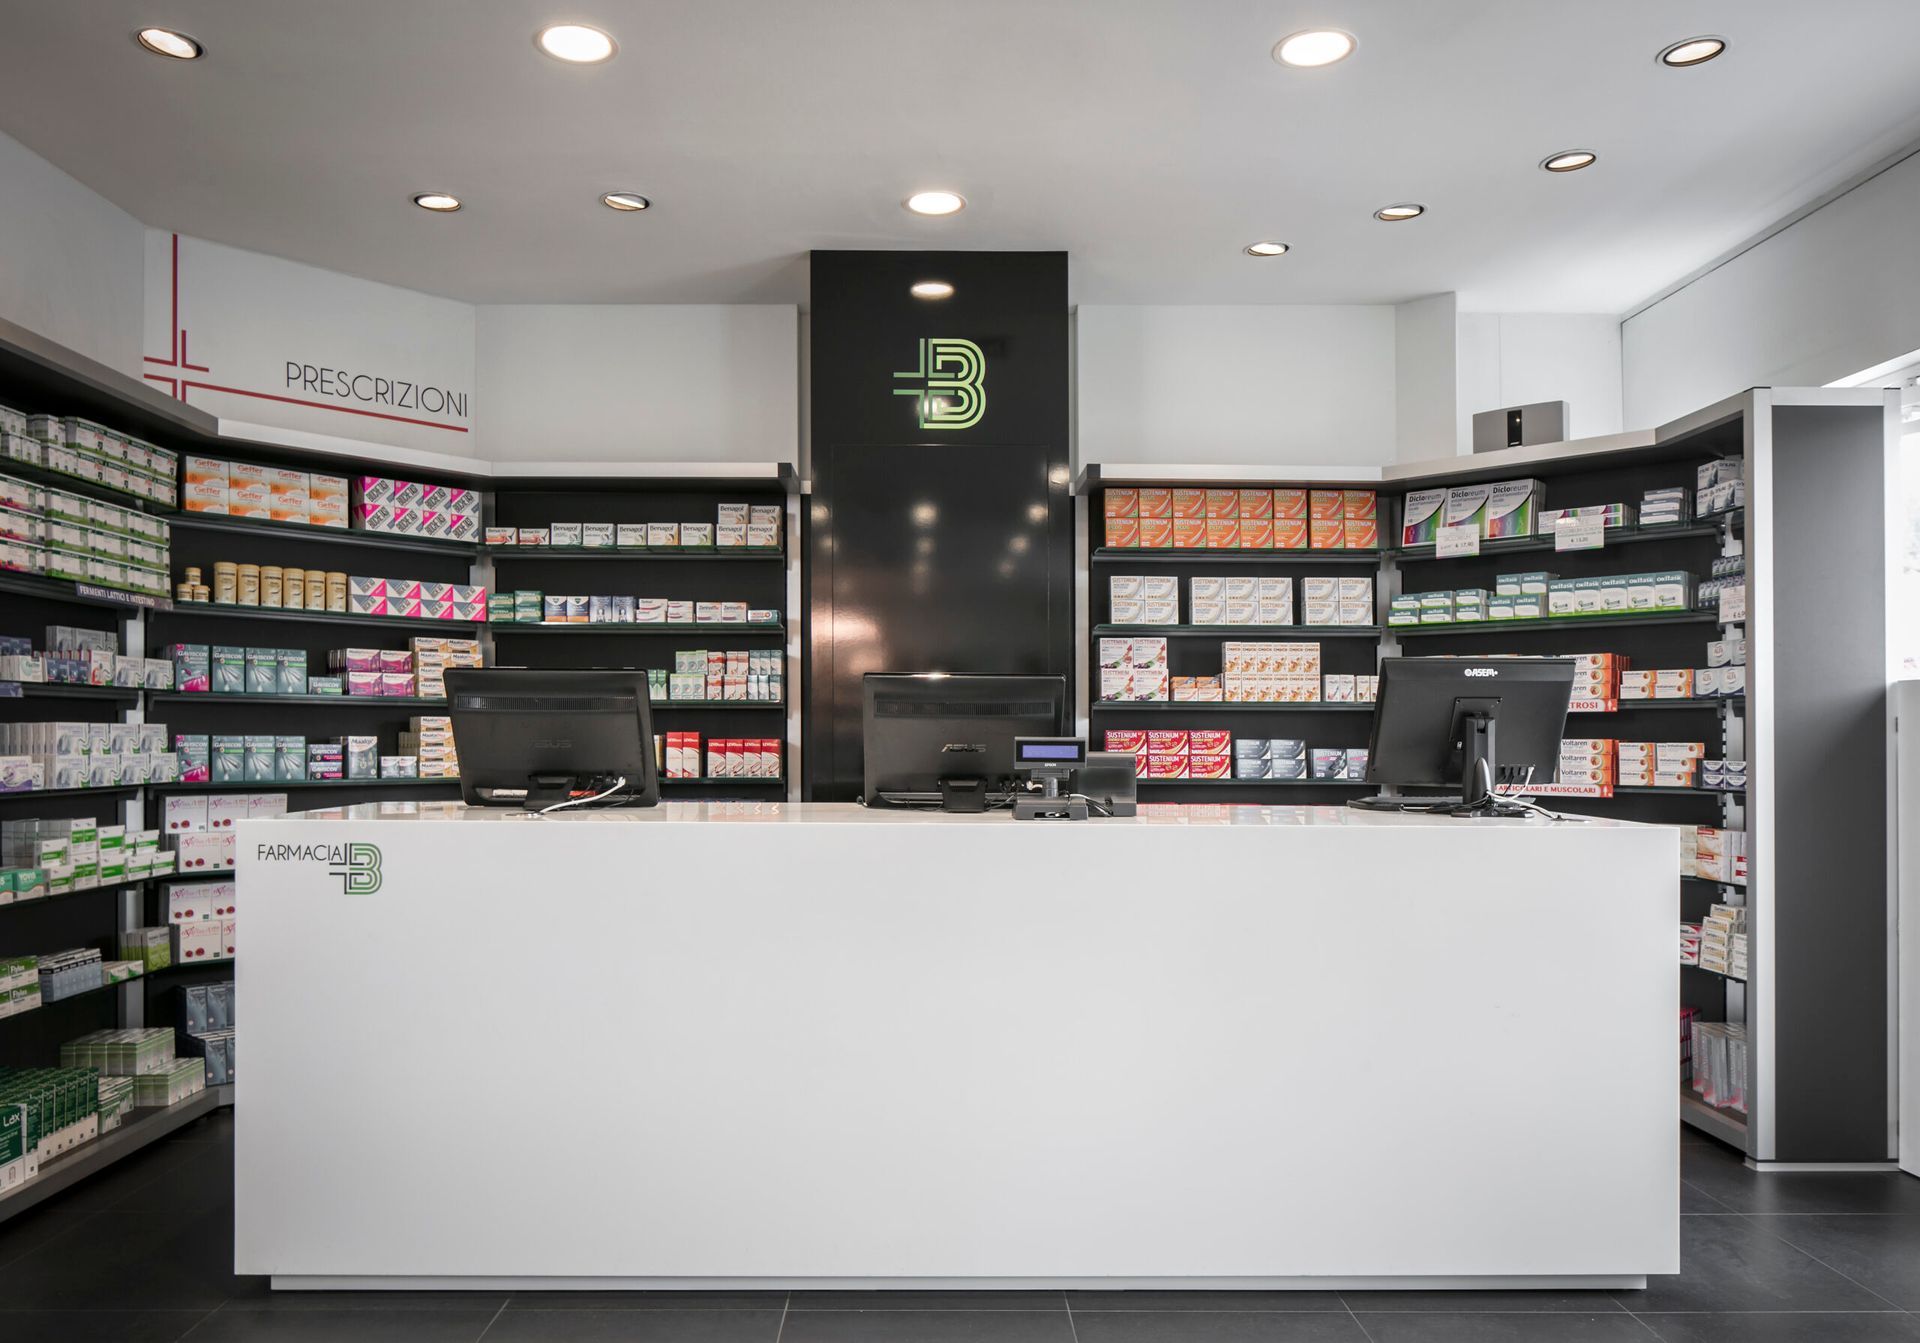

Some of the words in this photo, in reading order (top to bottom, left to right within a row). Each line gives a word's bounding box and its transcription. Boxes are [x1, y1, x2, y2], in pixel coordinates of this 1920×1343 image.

[287, 361, 467, 417] PRESCRIZIONI
[195, 458, 222, 468] Geffer
[237, 465, 263, 474] Geffer
[278, 471, 302, 480] Geffer
[317, 476, 340, 485] Geffer
[194, 486, 221, 496] Geffer
[1493, 484, 1529, 494] Dicloreum
[237, 491, 263, 500] Geffer
[1409, 493, 1441, 503] Dicloreum
[1451, 490, 1485, 499] Dicloreum
[278, 496, 302, 505] Geffer
[317, 501, 340, 510] Geffer
[80, 585, 106, 598] FERMENTI
[258, 844, 343, 861] FARMACIA
[4, 1112, 20, 1128] Lax
